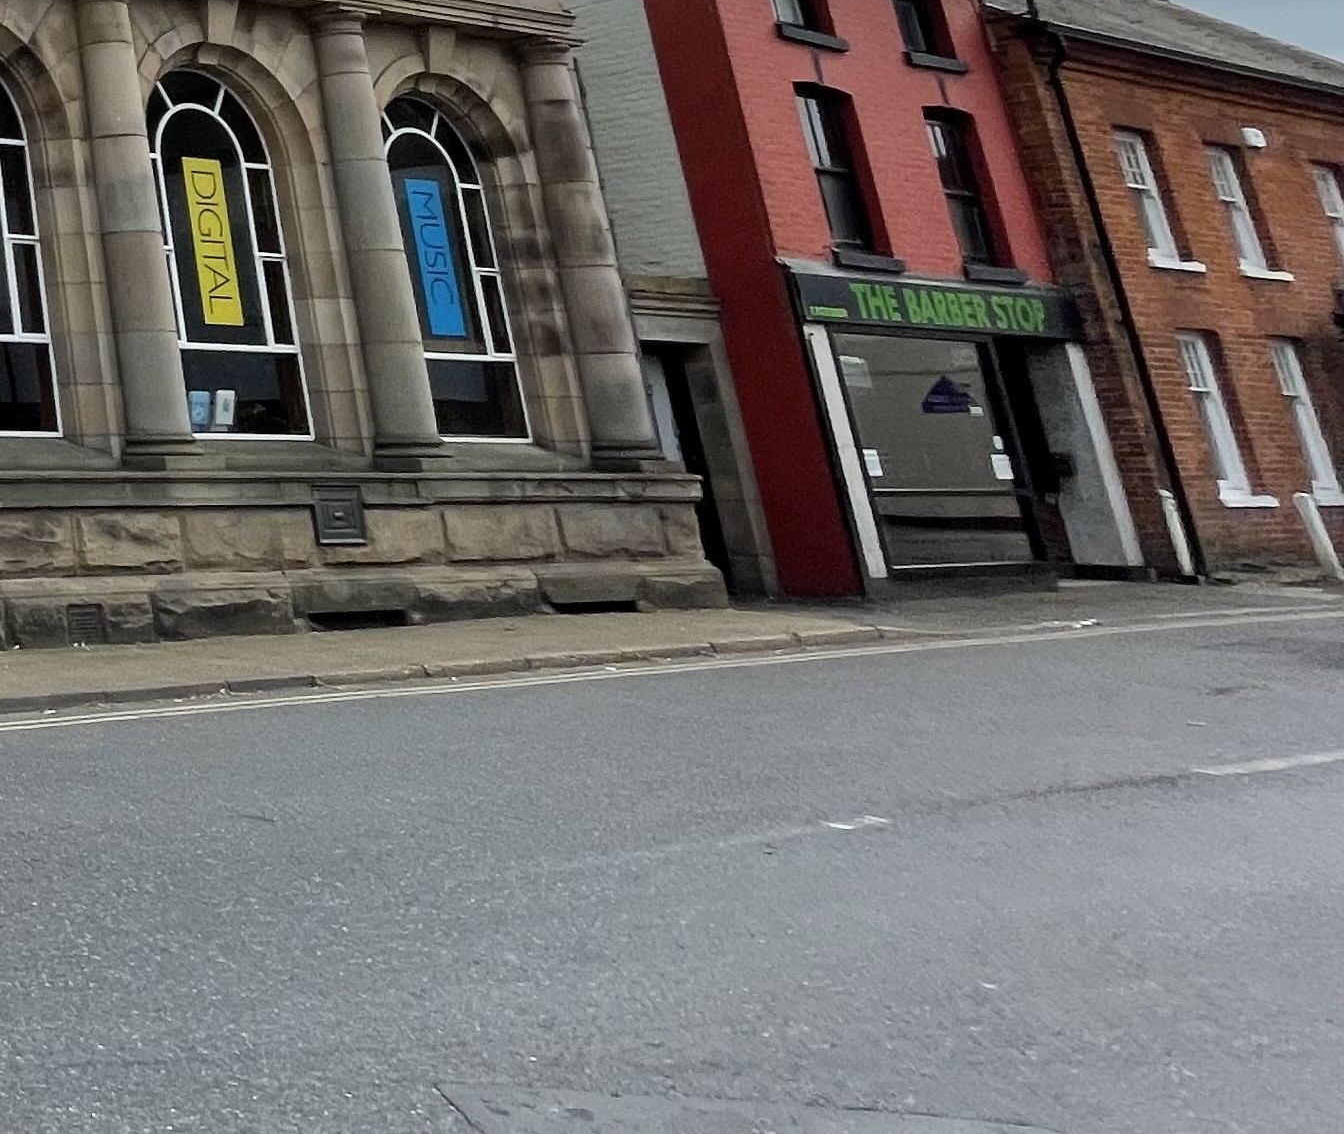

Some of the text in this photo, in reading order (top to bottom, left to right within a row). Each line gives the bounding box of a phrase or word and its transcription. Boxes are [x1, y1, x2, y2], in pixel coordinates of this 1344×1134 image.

[190, 170, 233, 315] DIGITAL
[412, 189, 454, 305] MUSIC
[849, 282, 1045, 333] THE BARBER STOP
